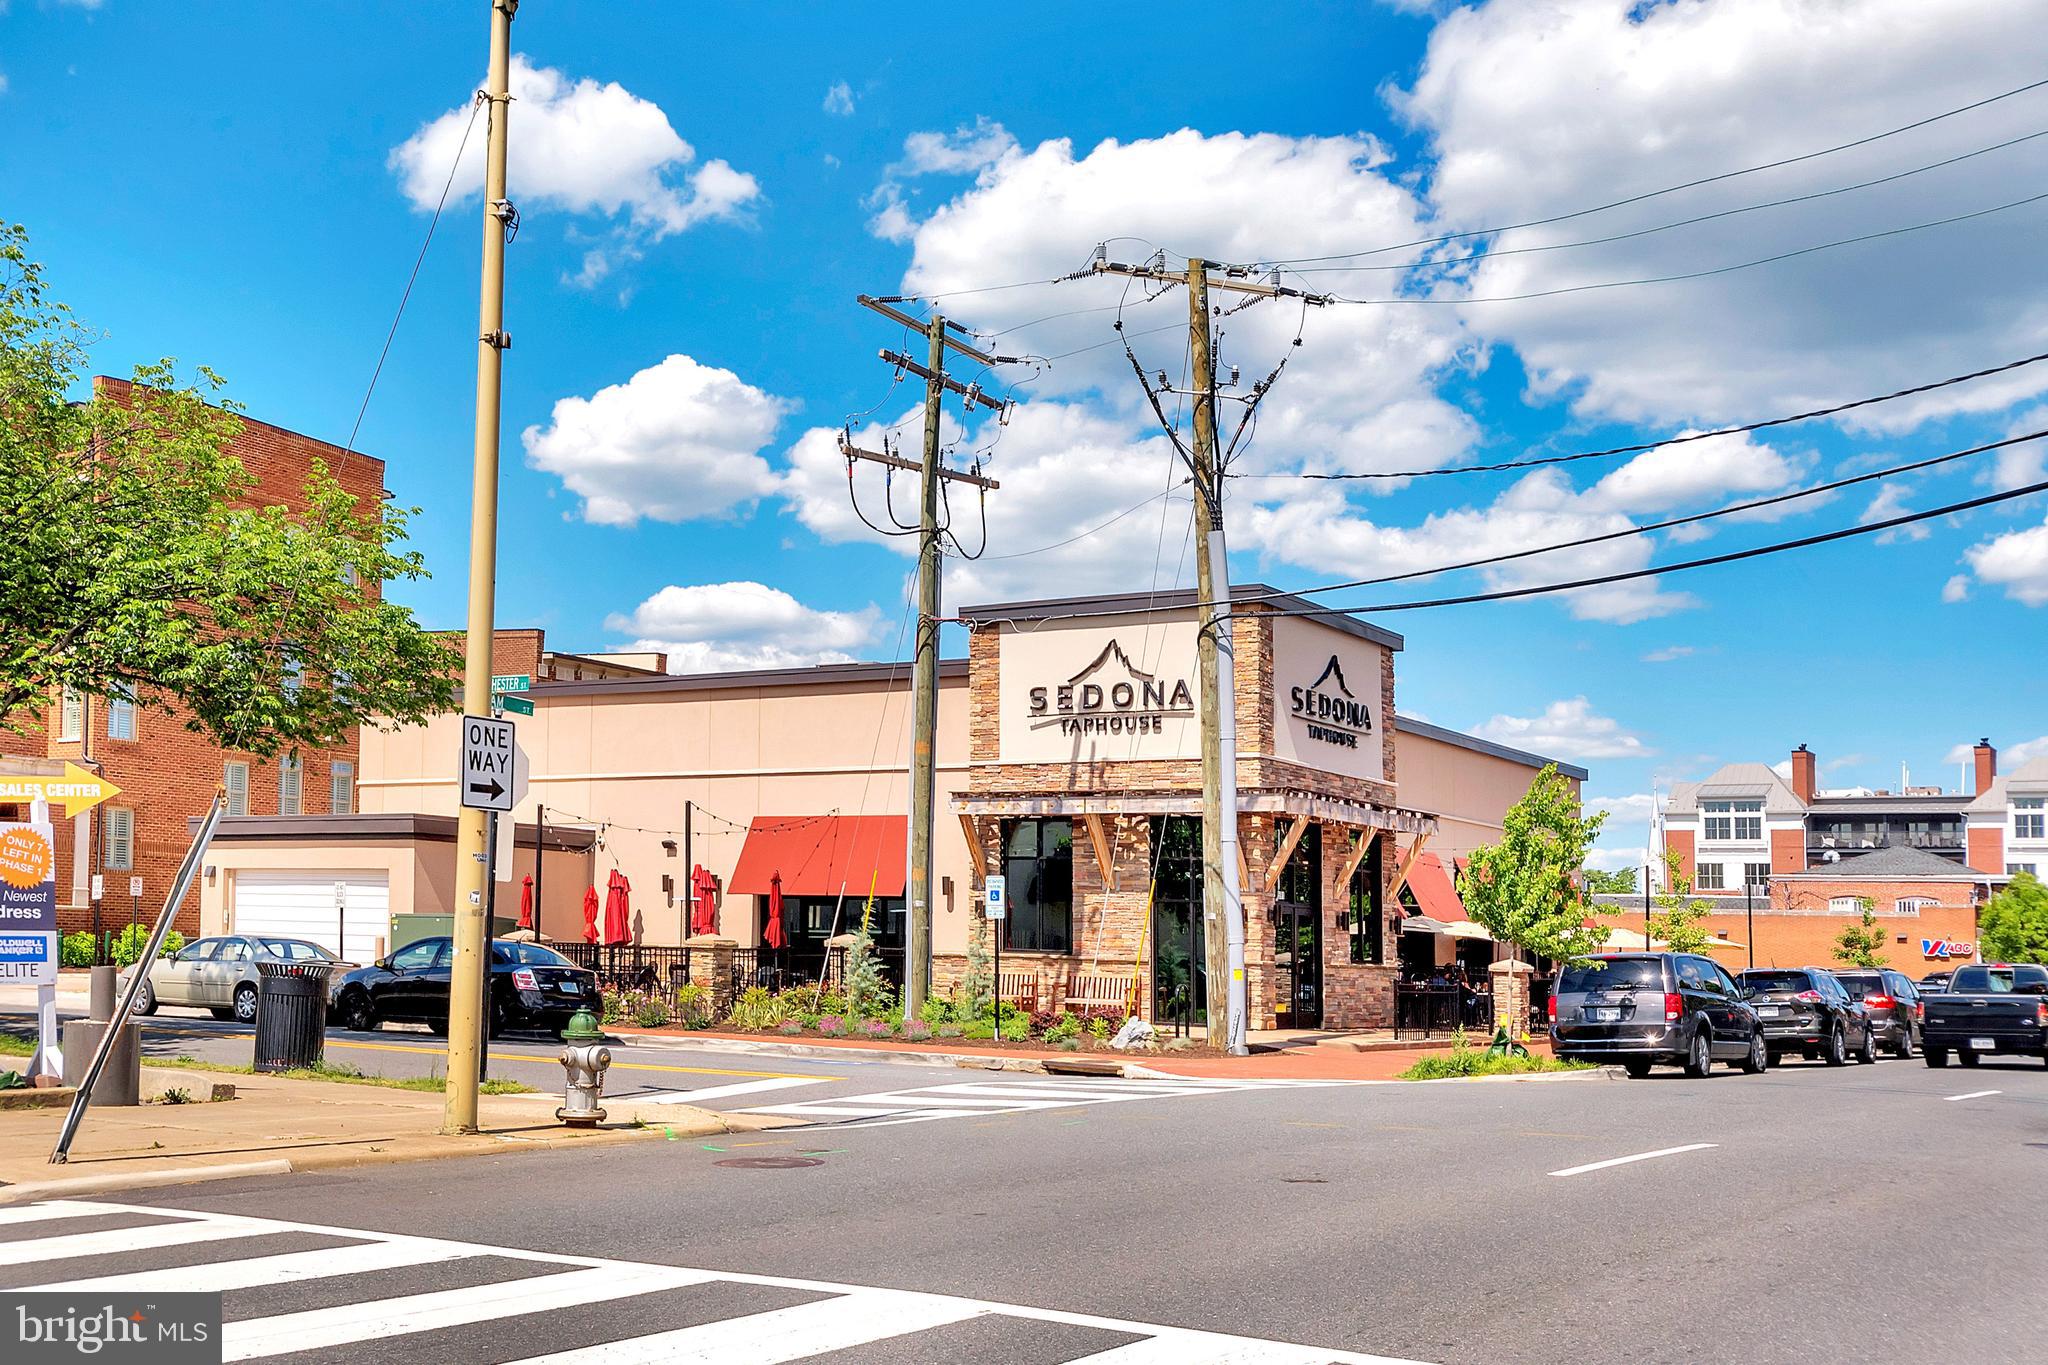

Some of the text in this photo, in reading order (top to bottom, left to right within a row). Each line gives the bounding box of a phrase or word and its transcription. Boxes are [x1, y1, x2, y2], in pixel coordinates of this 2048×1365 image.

[1029, 679, 1193, 711] SEDONA
[1291, 686, 1372, 730] SEDONA
[1061, 714, 1162, 736] TAPHOUSE
[470, 724, 508, 749] ONE
[1307, 724, 1358, 749] TAPHOUSE
[469, 749, 509, 774] WAY
[0, 783, 101, 797] SALES CENTER
[6, 835, 44, 852] ONLY 7
[3, 846, 43, 865] LEFT IN
[37, 867, 42, 876] 1
[3, 890, 48, 903] Newest
